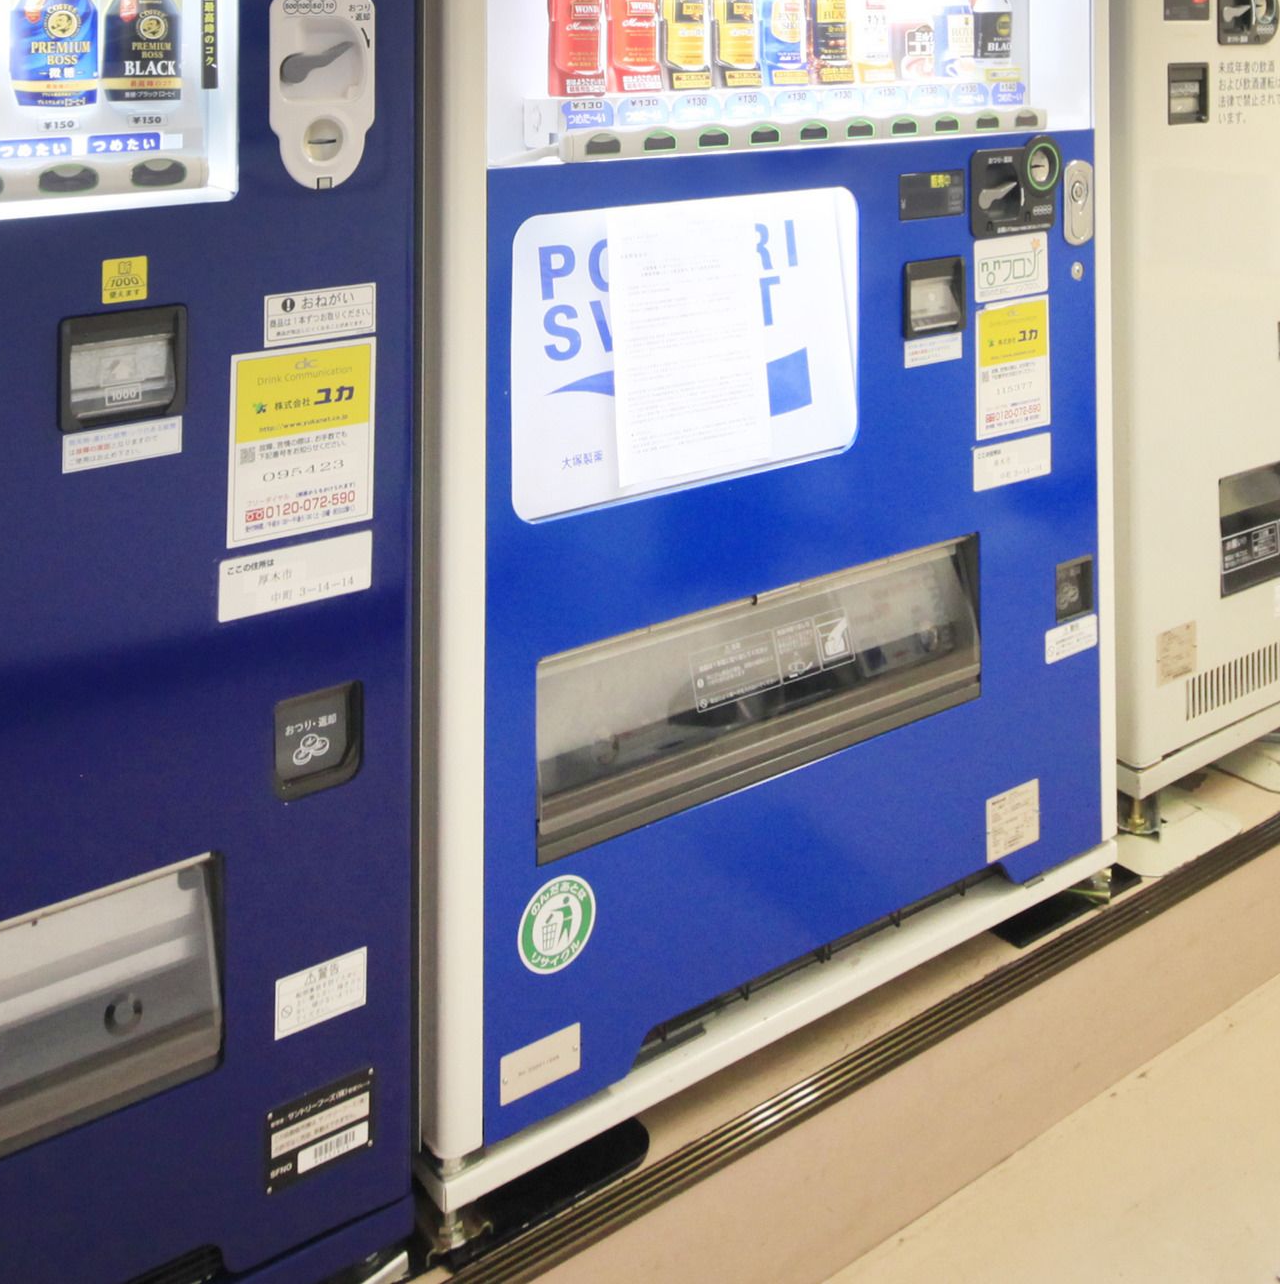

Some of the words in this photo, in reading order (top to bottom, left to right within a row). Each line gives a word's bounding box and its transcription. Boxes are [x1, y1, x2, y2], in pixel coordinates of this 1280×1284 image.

[348, 3, 371, 13] おつり
[30, 40, 92, 56] PREMIUM
[131, 41, 172, 52] PREMIUM
[124, 59, 177, 77] BLACK
[1218, 61, 1276, 75] 未成年者の飲酒
[43, 119, 76, 131] ¥150
[131, 114, 163, 126] ¥150
[110, 277, 139, 288] 1000
[300, 292, 356, 311] おねがい
[1017, 329, 1039, 343] ユカ
[257, 374, 283, 387] Drink
[284, 366, 354, 383] Communication
[111, 388, 138, 402] 1000
[274, 397, 312, 412] 株式会社
[313, 385, 356, 406] ユカ
[561, 449, 604, 470] 大塚製薬
[262, 459, 345, 483] 095423
[265, 490, 357, 520] 0120-072-590
[227, 559, 275, 577] ここの住所は
[531, 939, 582, 968] リサイクル
[318, 962, 340, 982] 警告
